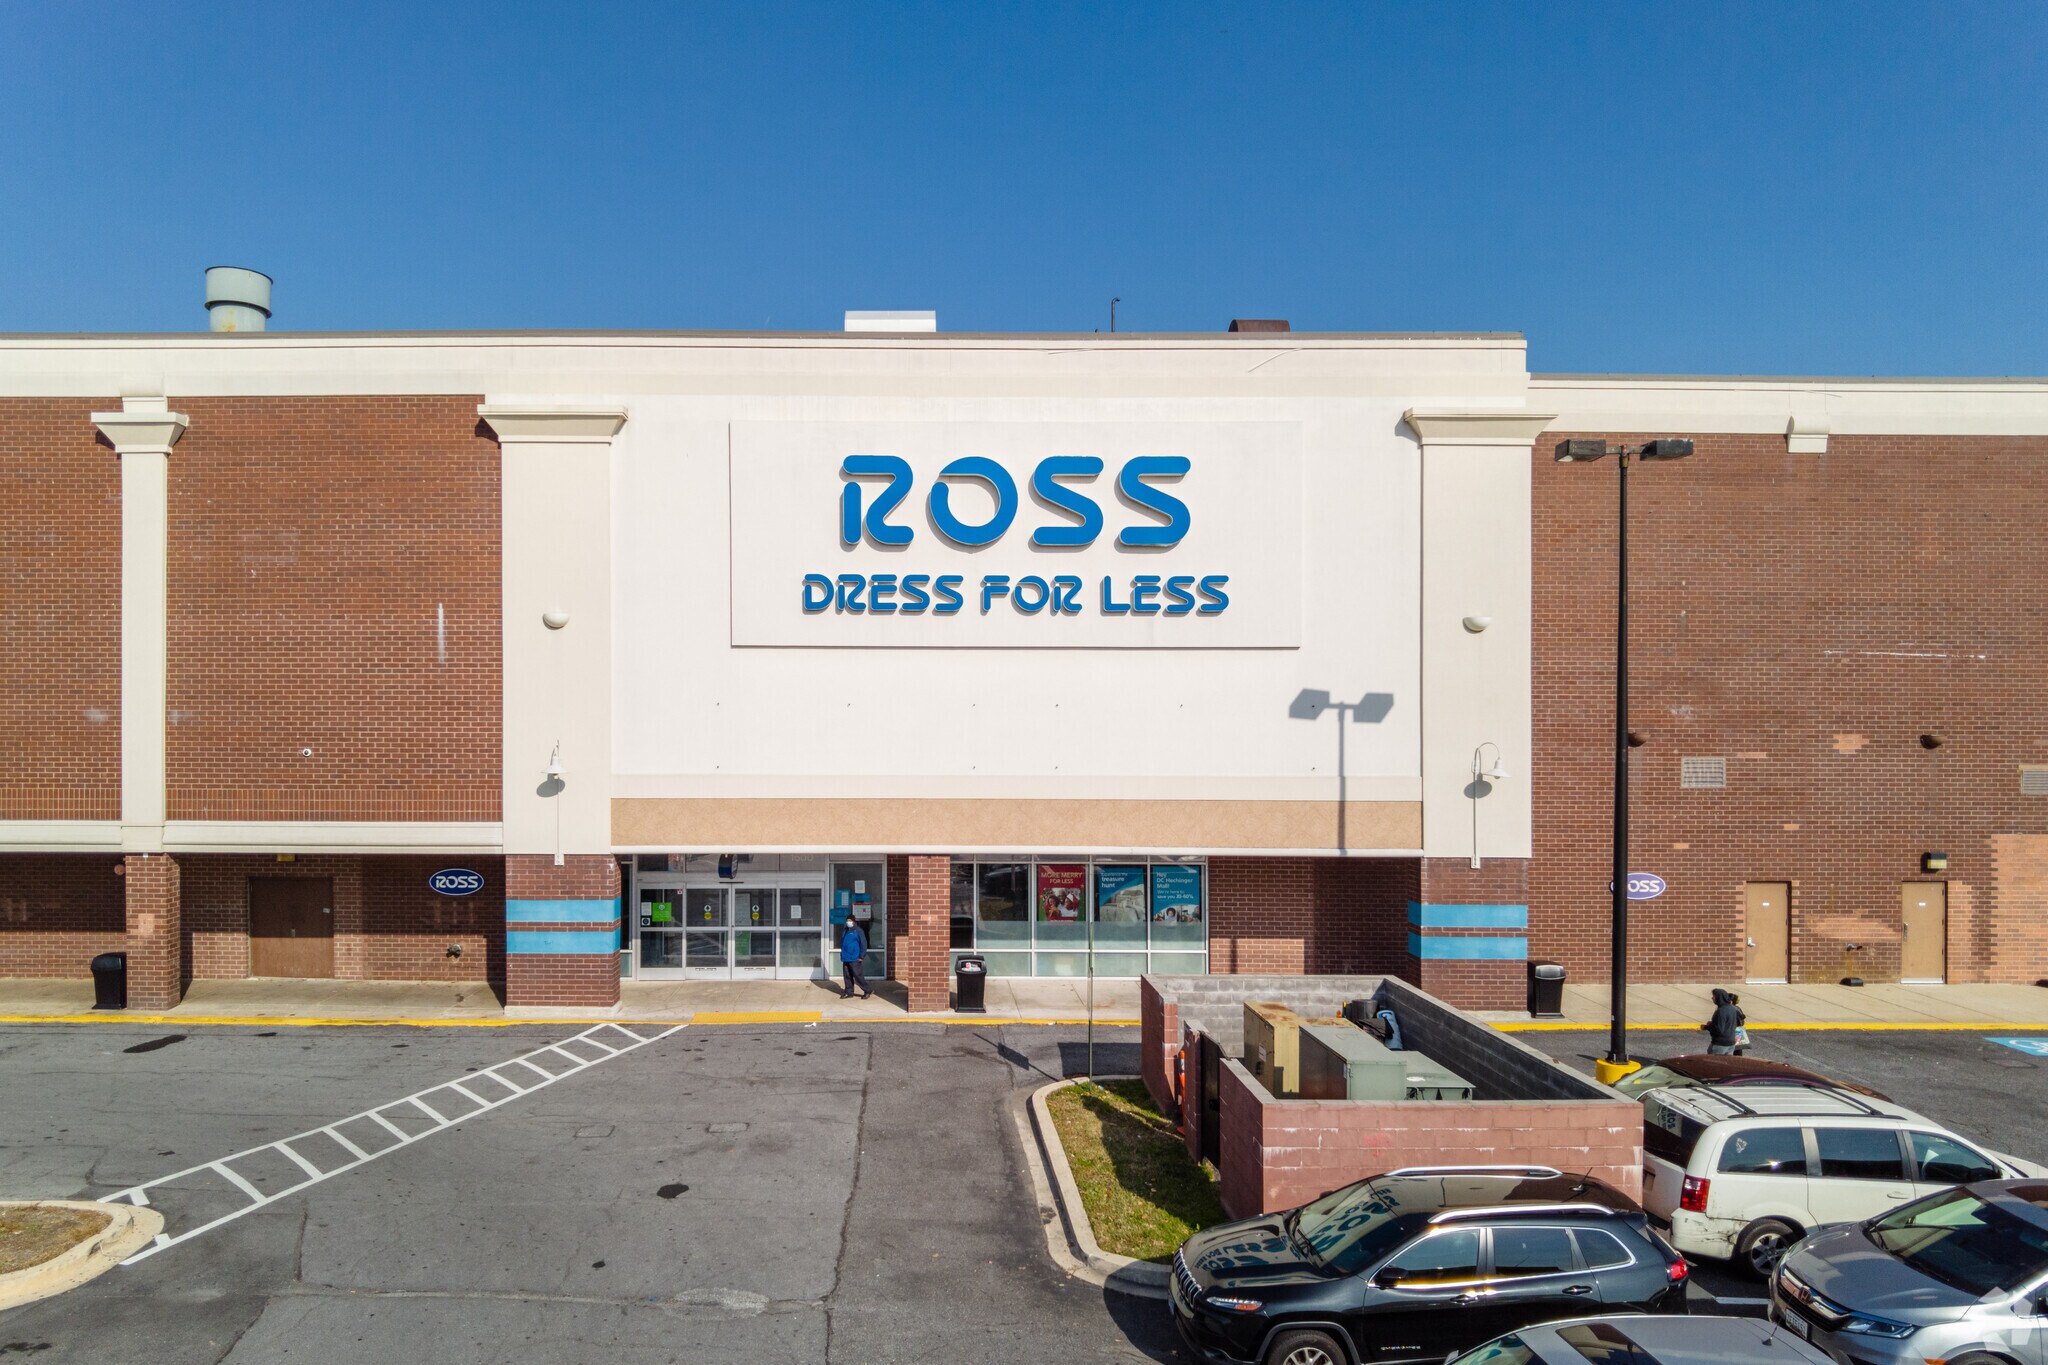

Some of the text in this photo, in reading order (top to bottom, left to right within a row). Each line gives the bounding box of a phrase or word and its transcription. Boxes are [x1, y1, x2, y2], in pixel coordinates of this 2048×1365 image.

[842, 454, 1192, 546] ROSS
[803, 573, 1231, 613] DRESS FOR LESS
[435, 876, 478, 888] ROSS
[1627, 880, 1660, 893] OSS
